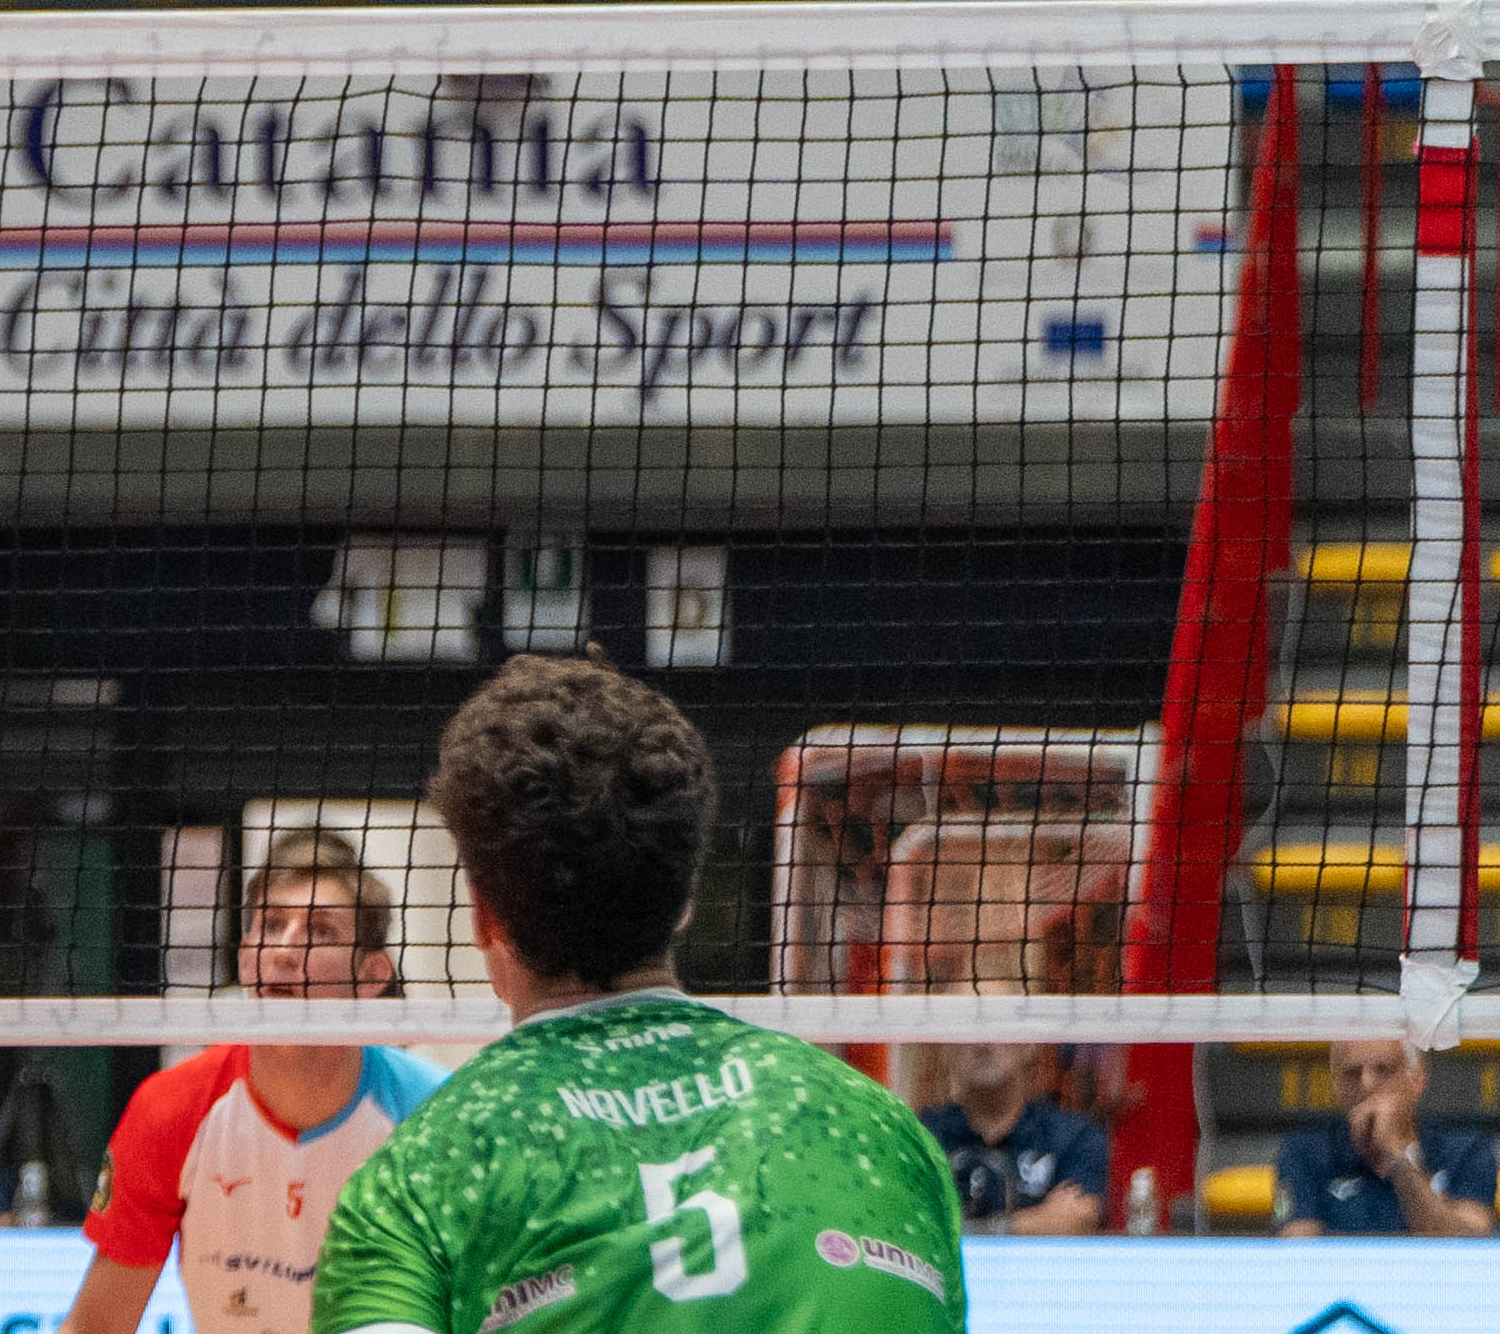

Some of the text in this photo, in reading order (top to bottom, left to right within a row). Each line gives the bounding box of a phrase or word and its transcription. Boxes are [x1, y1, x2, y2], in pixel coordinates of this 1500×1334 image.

[16, 75, 662, 207] Catania
[283, 267, 538, 373] dello
[566, 267, 876, 405] Sport
[556, 1057, 753, 1127] NOVELLO
[286, 1180, 307, 1220] 5
[637, 1146, 749, 1304] 5
